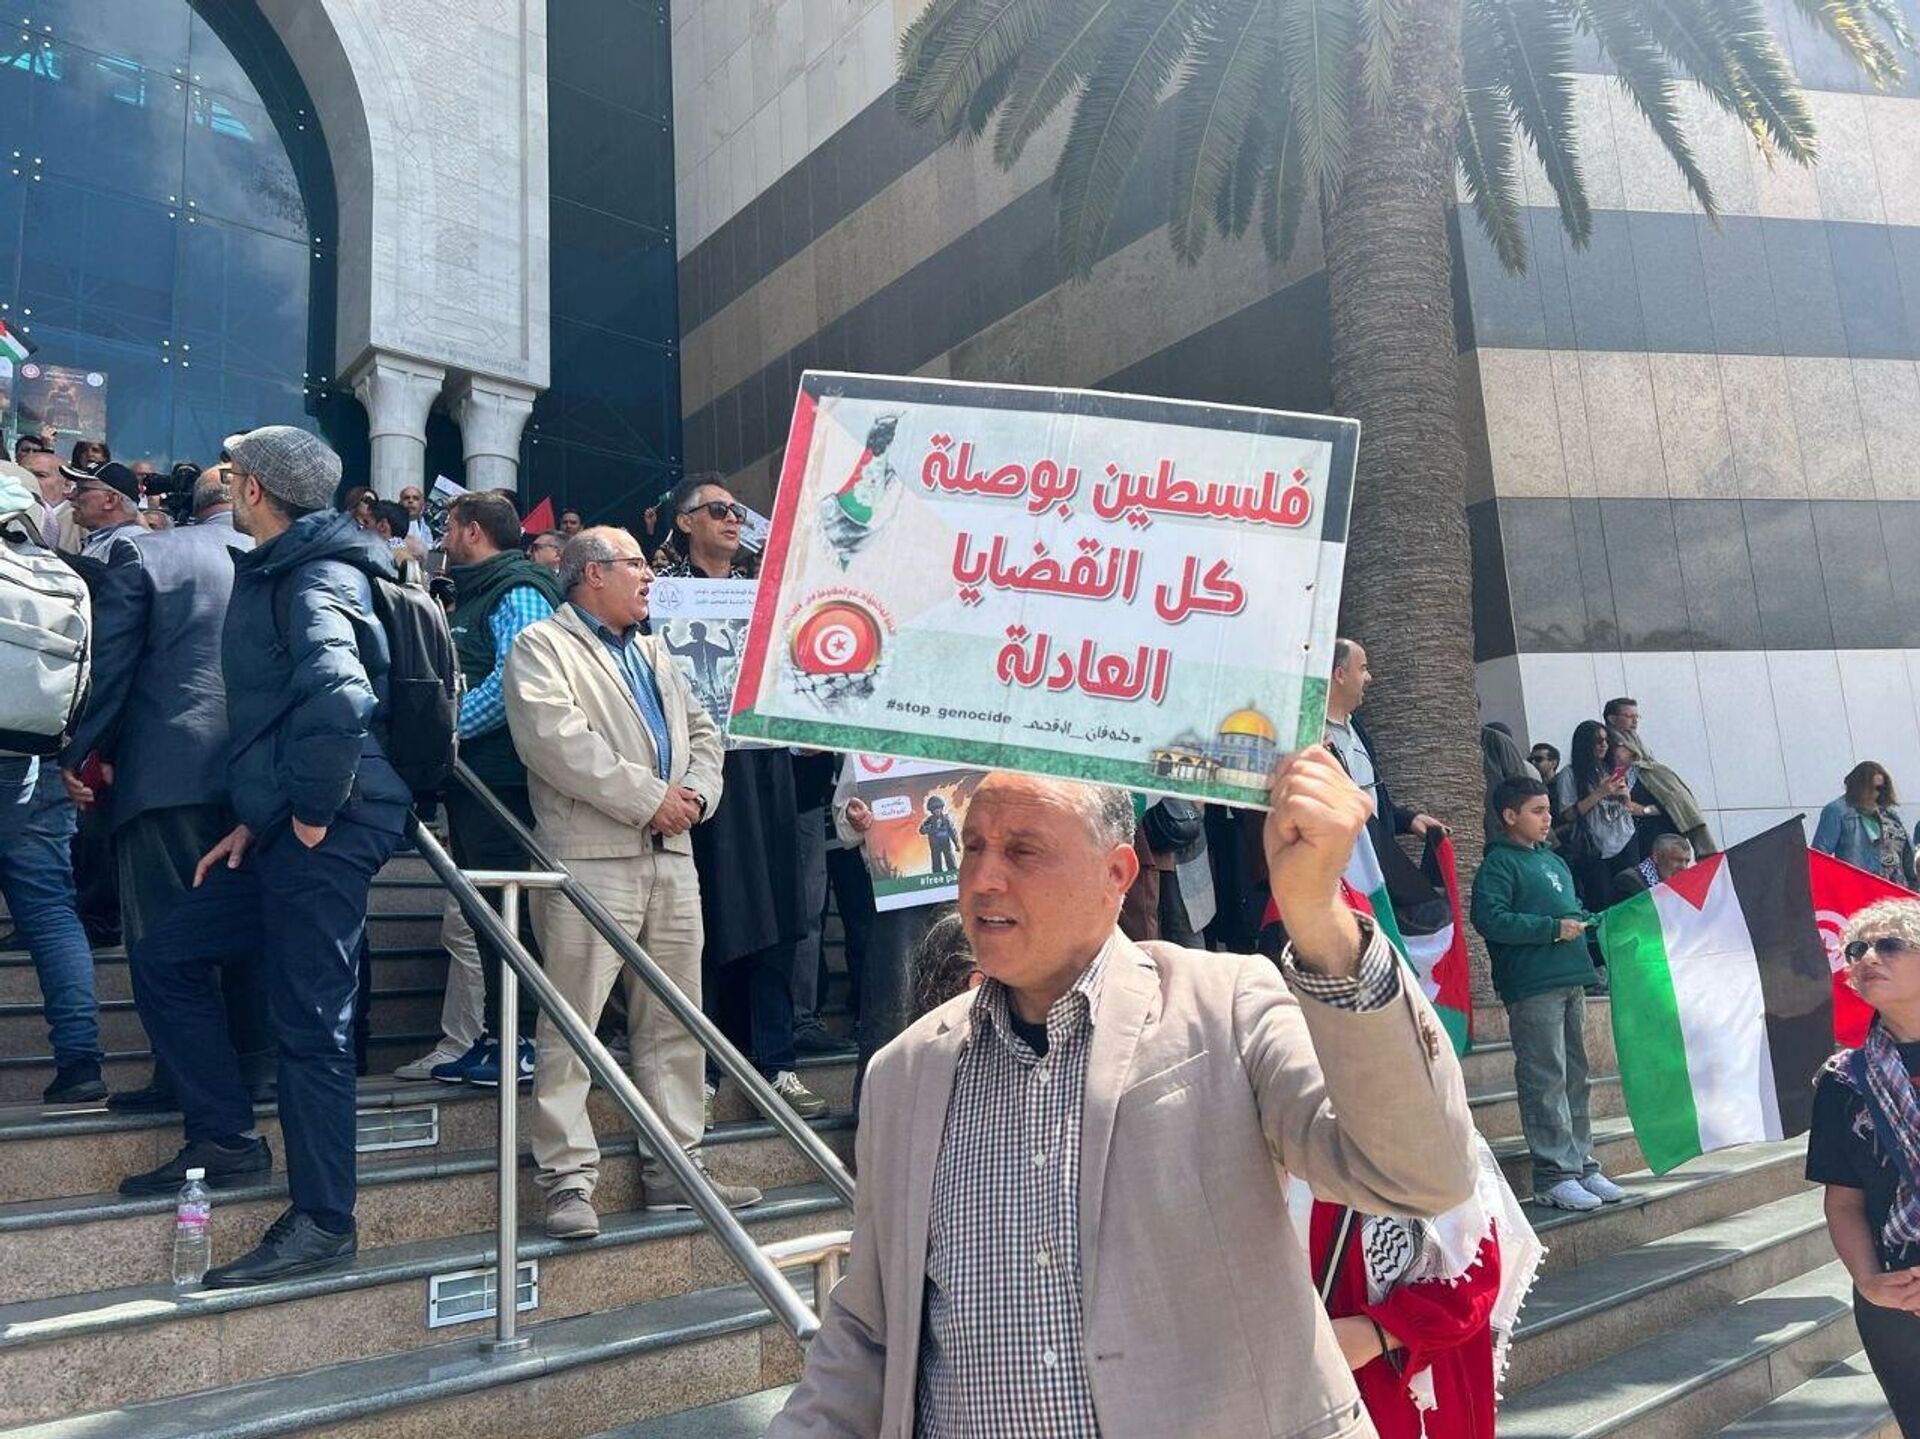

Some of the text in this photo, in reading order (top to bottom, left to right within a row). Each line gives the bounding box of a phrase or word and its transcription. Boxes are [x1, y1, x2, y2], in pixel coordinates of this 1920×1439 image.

[921, 435, 1311, 526] فلسطين بوصلة
[952, 535, 1245, 622] كل القضايا
[996, 625, 1168, 699] العادلة
